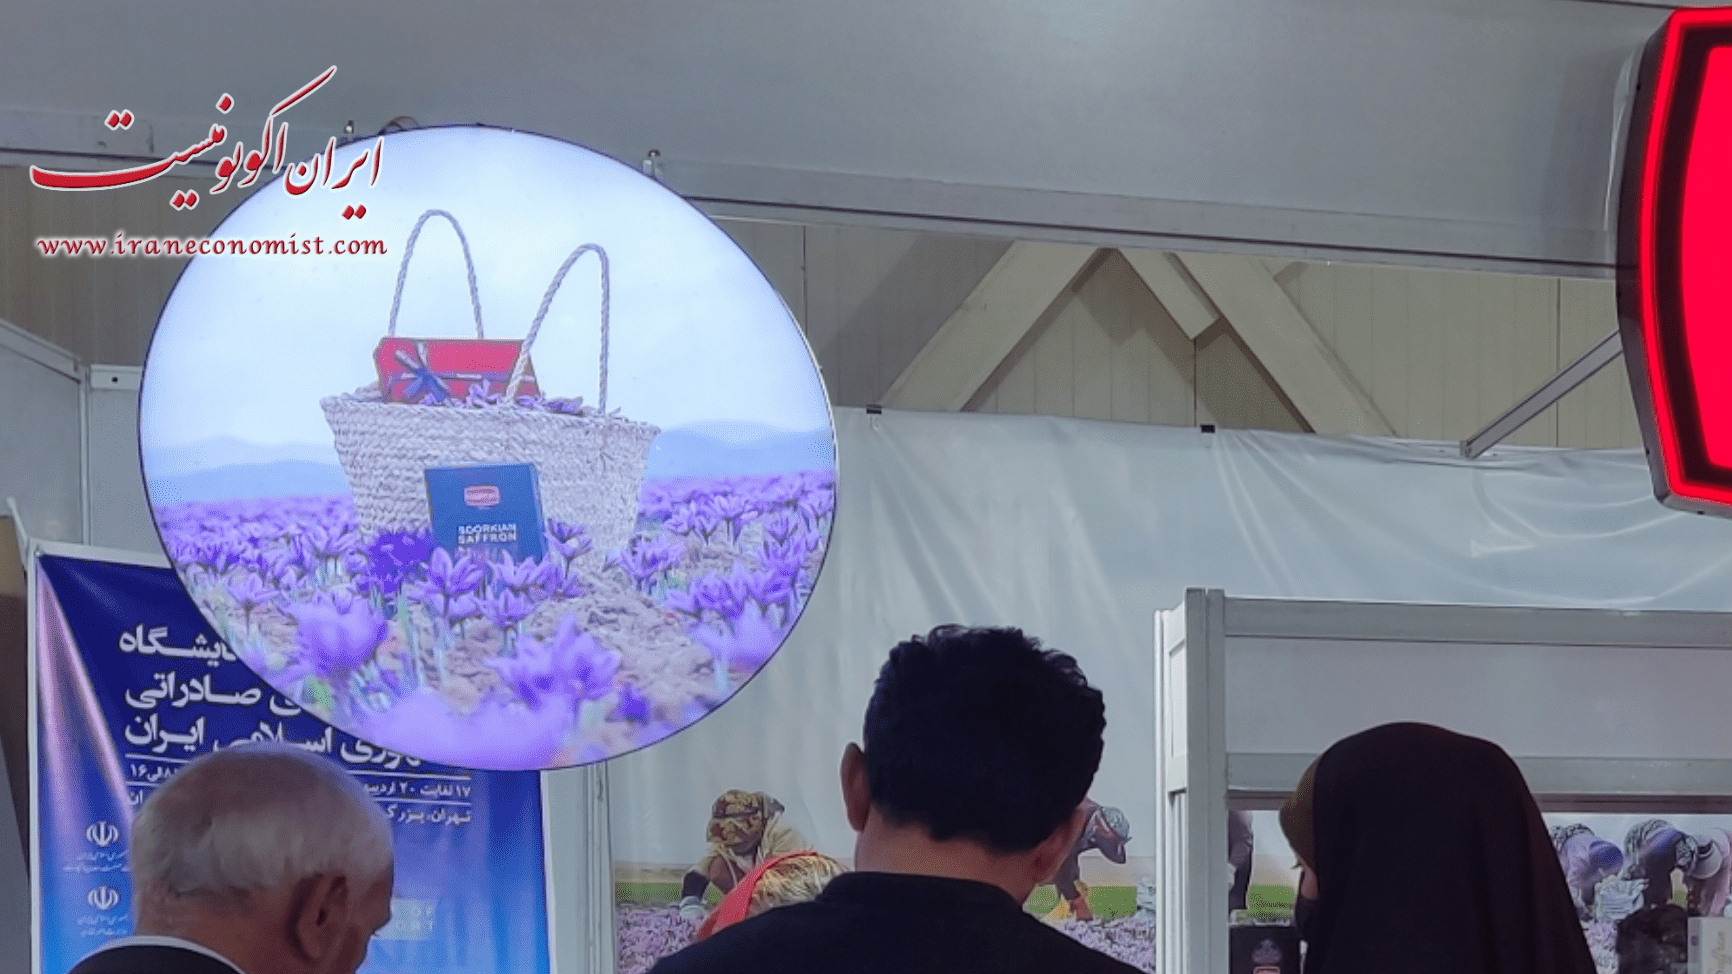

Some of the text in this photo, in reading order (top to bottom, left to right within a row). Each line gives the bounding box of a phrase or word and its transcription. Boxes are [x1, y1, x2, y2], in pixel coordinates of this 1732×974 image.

[119, 623, 237, 668] ایشگاه
[125, 671, 262, 709] صادراتی
[125, 713, 206, 753] ایران
